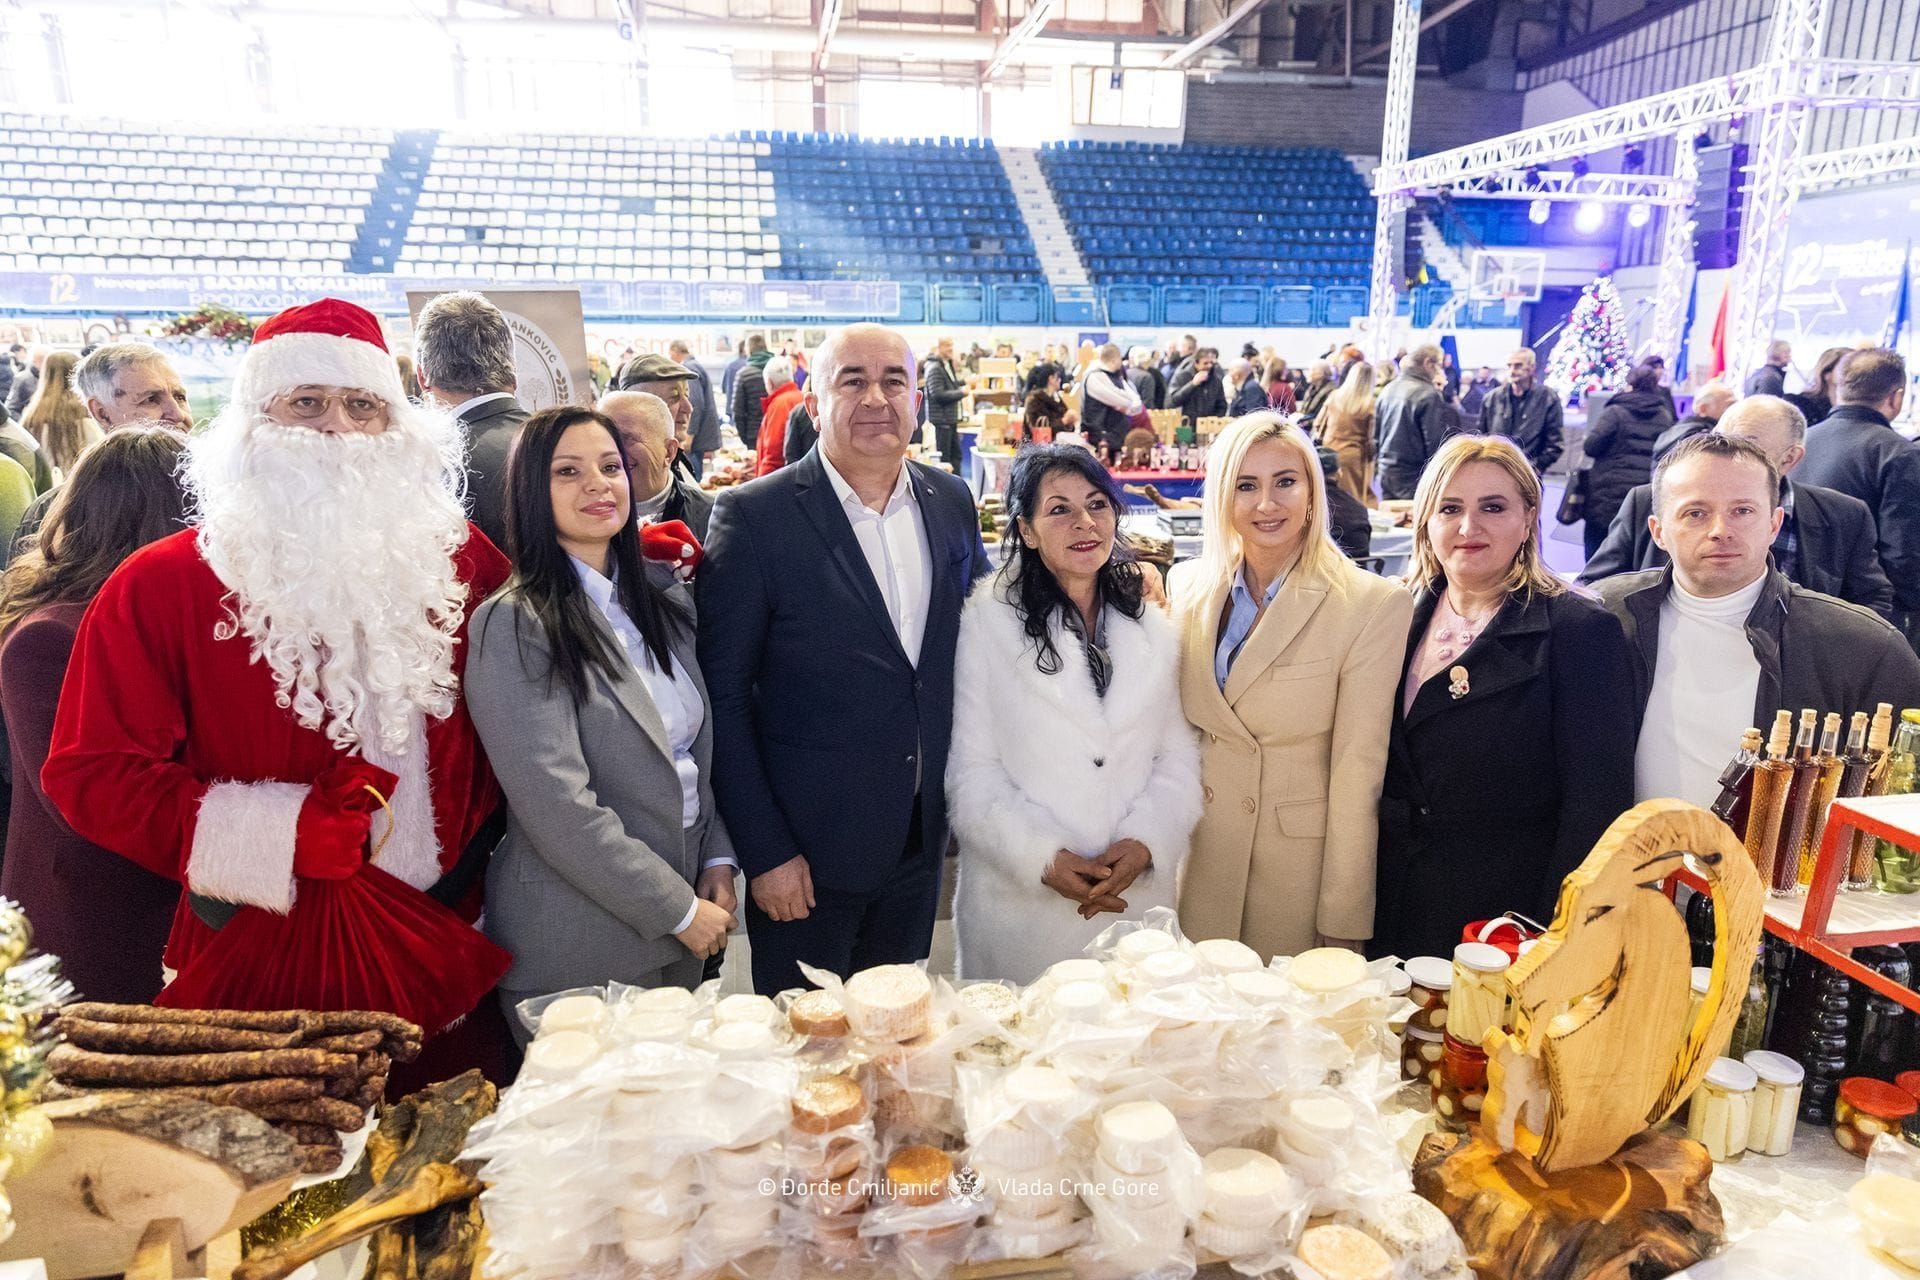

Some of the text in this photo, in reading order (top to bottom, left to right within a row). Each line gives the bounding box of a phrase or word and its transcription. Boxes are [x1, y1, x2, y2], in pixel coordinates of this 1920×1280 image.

[620, 23, 632, 41] G
[1111, 72, 1122, 89] H
[1783, 241, 1823, 293] 12
[49, 274, 79, 304] 12
[203, 276, 277, 292] SAJAM
[508, 319, 557, 364] ANKOVIĆ
